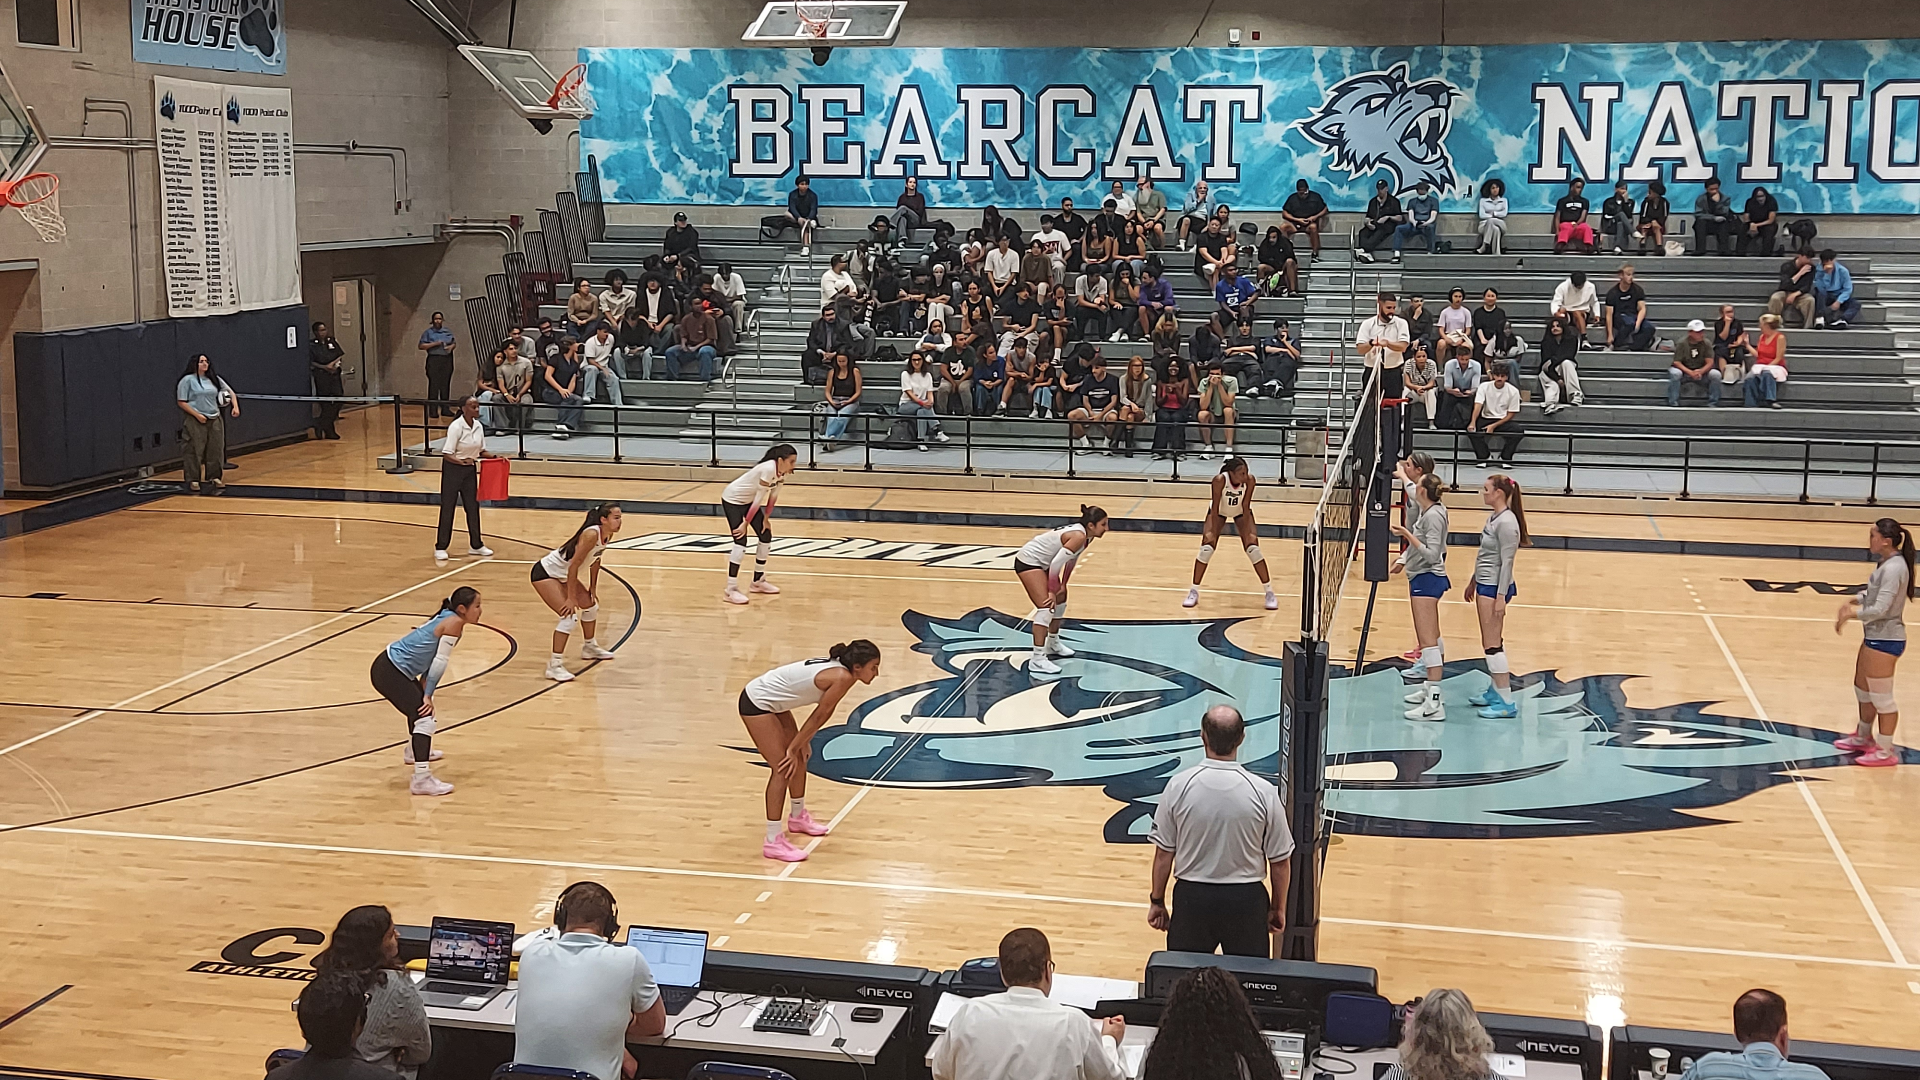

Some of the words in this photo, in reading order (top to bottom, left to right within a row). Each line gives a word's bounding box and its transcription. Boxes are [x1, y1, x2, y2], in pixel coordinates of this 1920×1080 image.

[141, 6, 239, 51] HOUSE
[727, 84, 1263, 183] BEARCAT
[866, 987, 913, 999] NEVCO
[1248, 982, 1277, 991] NEVCO
[1527, 1041, 1580, 1055] NEVCO
